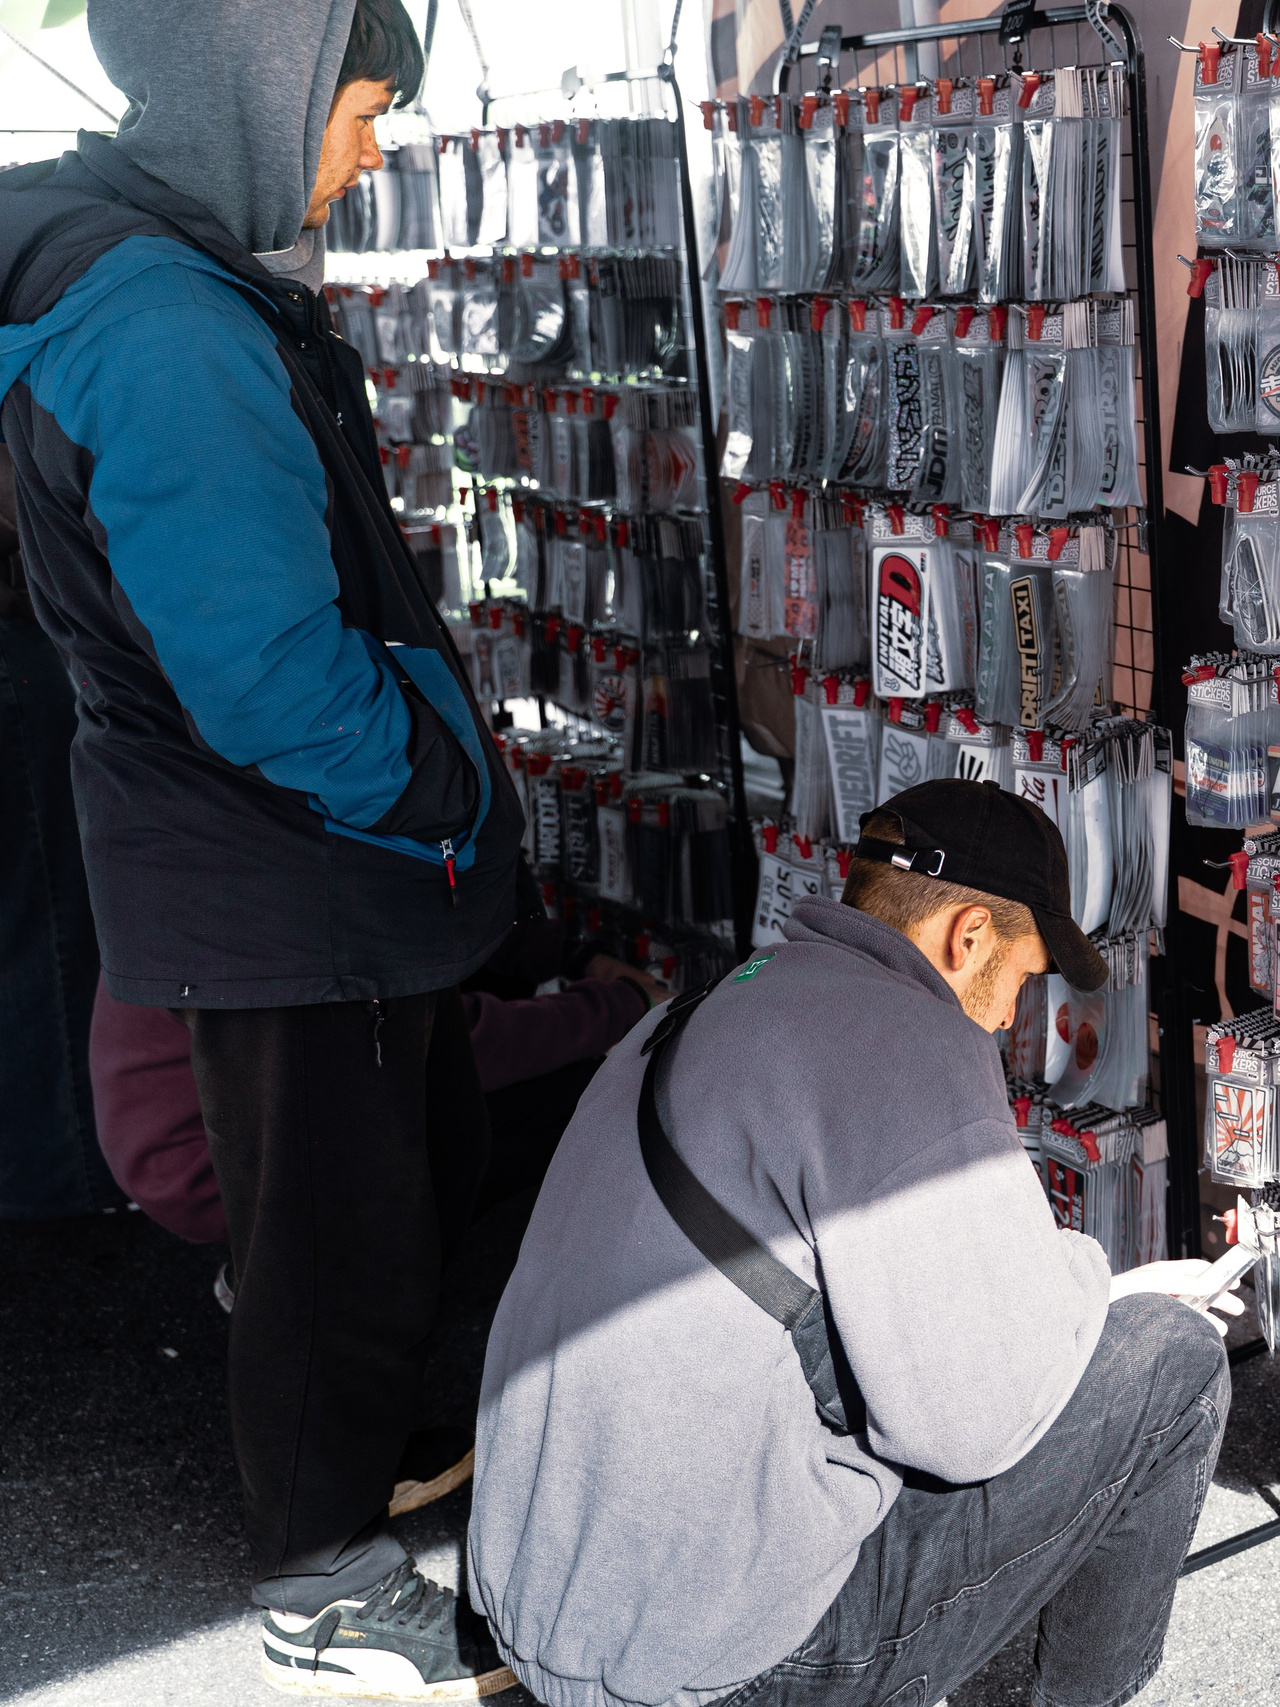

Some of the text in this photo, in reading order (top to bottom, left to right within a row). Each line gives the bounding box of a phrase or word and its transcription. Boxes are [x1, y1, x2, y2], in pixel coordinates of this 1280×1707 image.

[927, 428, 949, 498] JDM
[872, 525, 924, 542] STIERS
[879, 595, 890, 664] INITIAL
[978, 571, 996, 707] TAKATA
[1015, 590, 1035, 647] TAXI
[1020, 652, 1041, 728] DRIFT
[1190, 685, 1231, 701] STICKERS
[1209, 1055, 1258, 1072] STKERS
